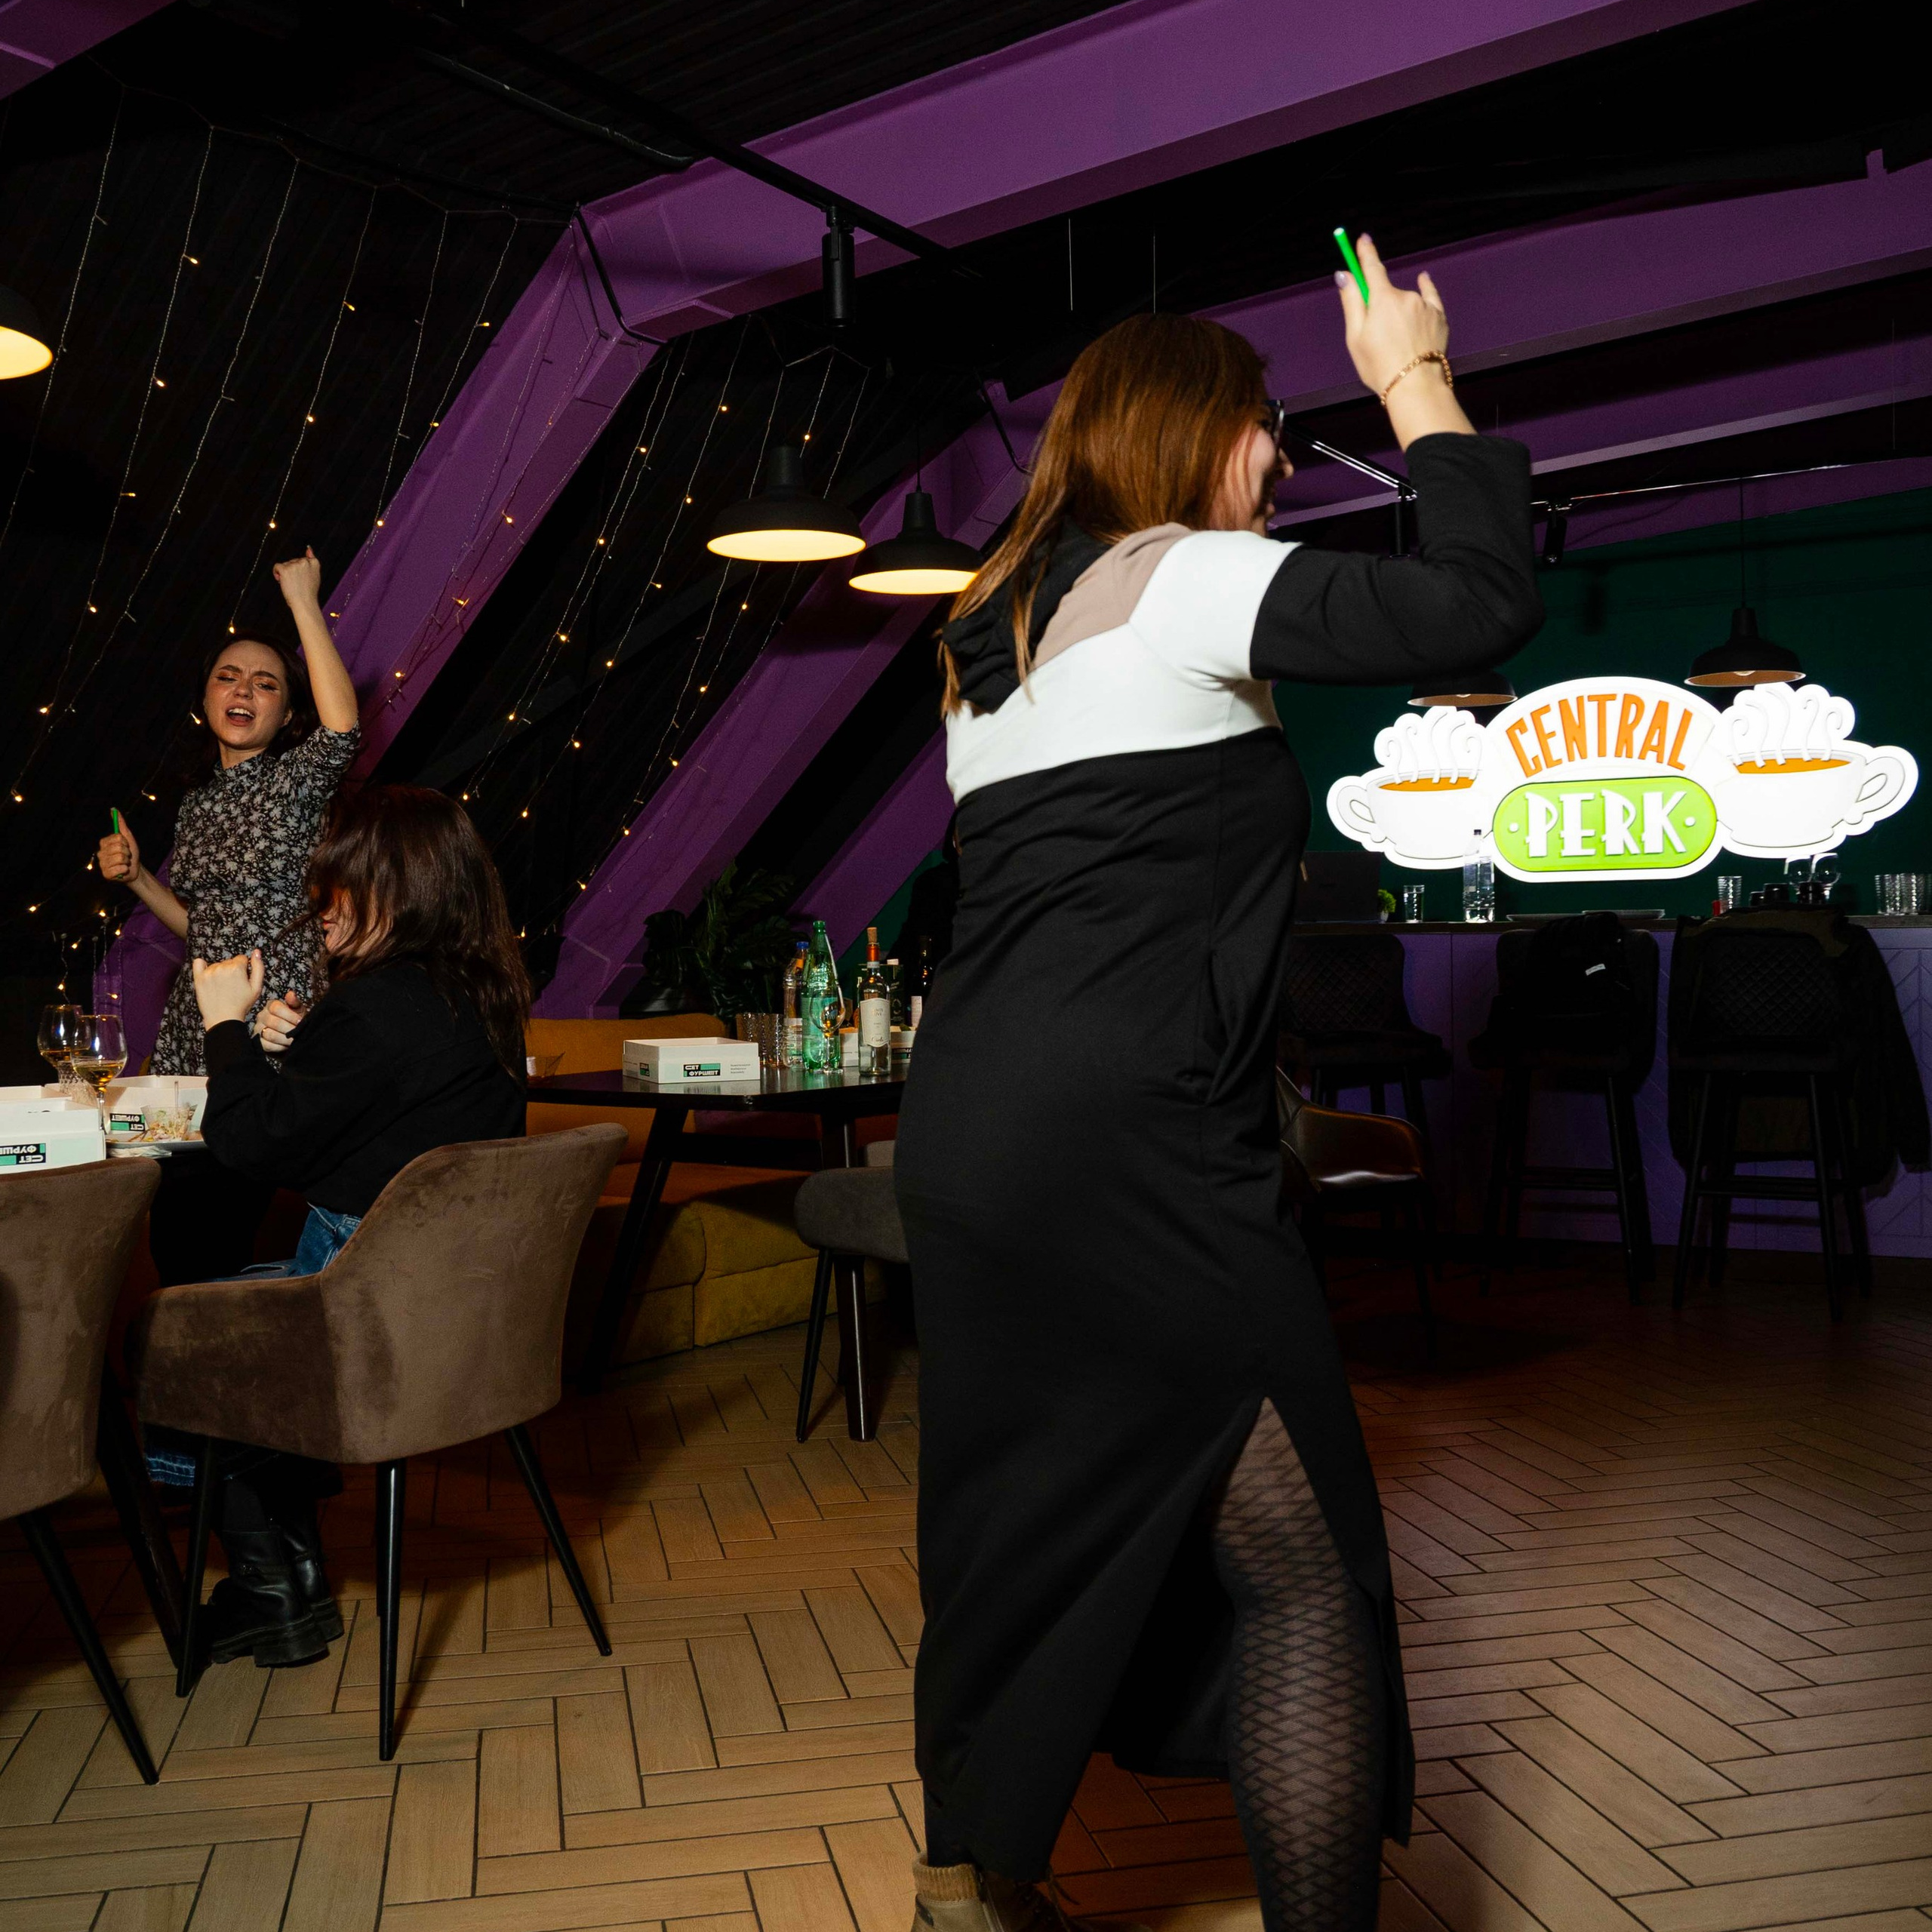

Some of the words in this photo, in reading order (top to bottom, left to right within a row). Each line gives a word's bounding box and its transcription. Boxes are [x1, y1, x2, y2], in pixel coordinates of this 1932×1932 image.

[1506, 694, 1693, 778] CENTRAL
[1524, 789, 1687, 857] PERK
[19, 1155, 44, 1164] СЕТ
